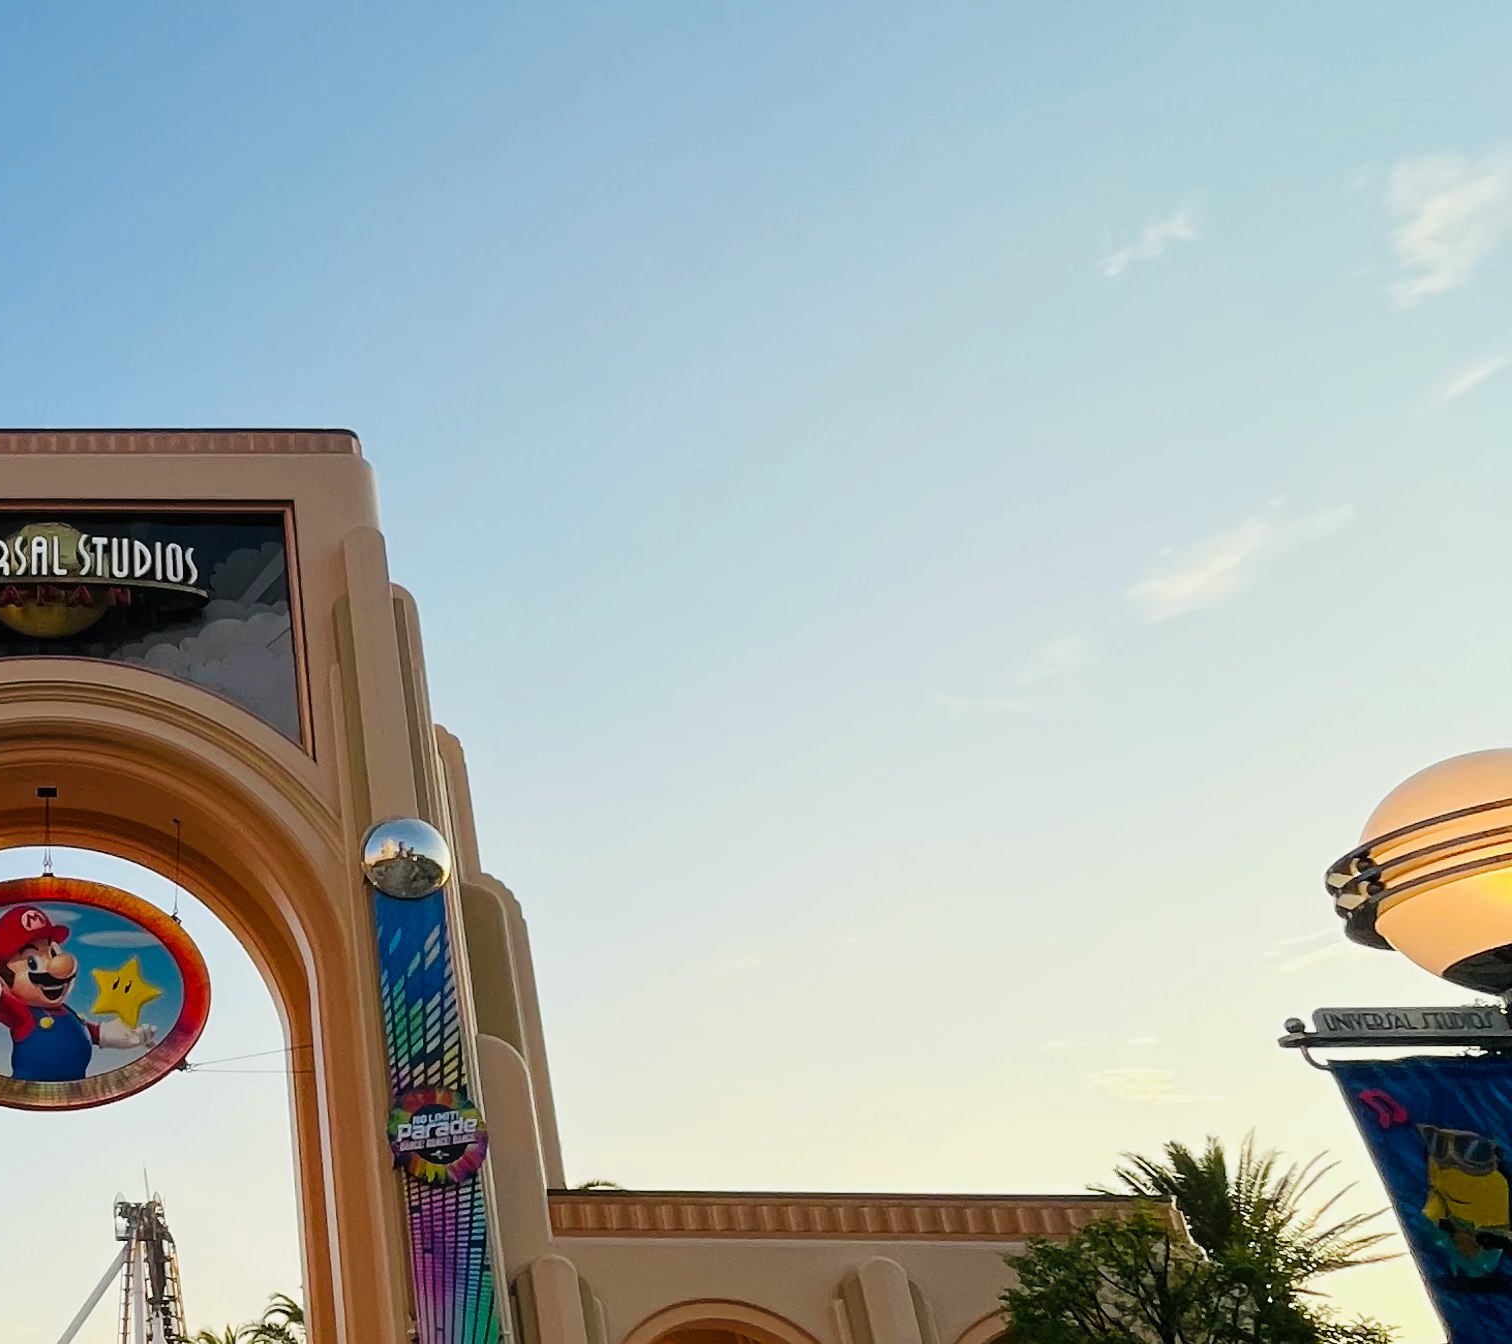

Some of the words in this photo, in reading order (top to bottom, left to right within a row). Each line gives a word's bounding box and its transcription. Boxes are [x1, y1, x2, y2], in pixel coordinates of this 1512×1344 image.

[78, 534, 199, 585] STUDIOS
[25, 912, 46, 928] M
[1323, 1012, 1419, 1032] UNIVERSAL
[1421, 1011, 1495, 1030] STUDIOS
